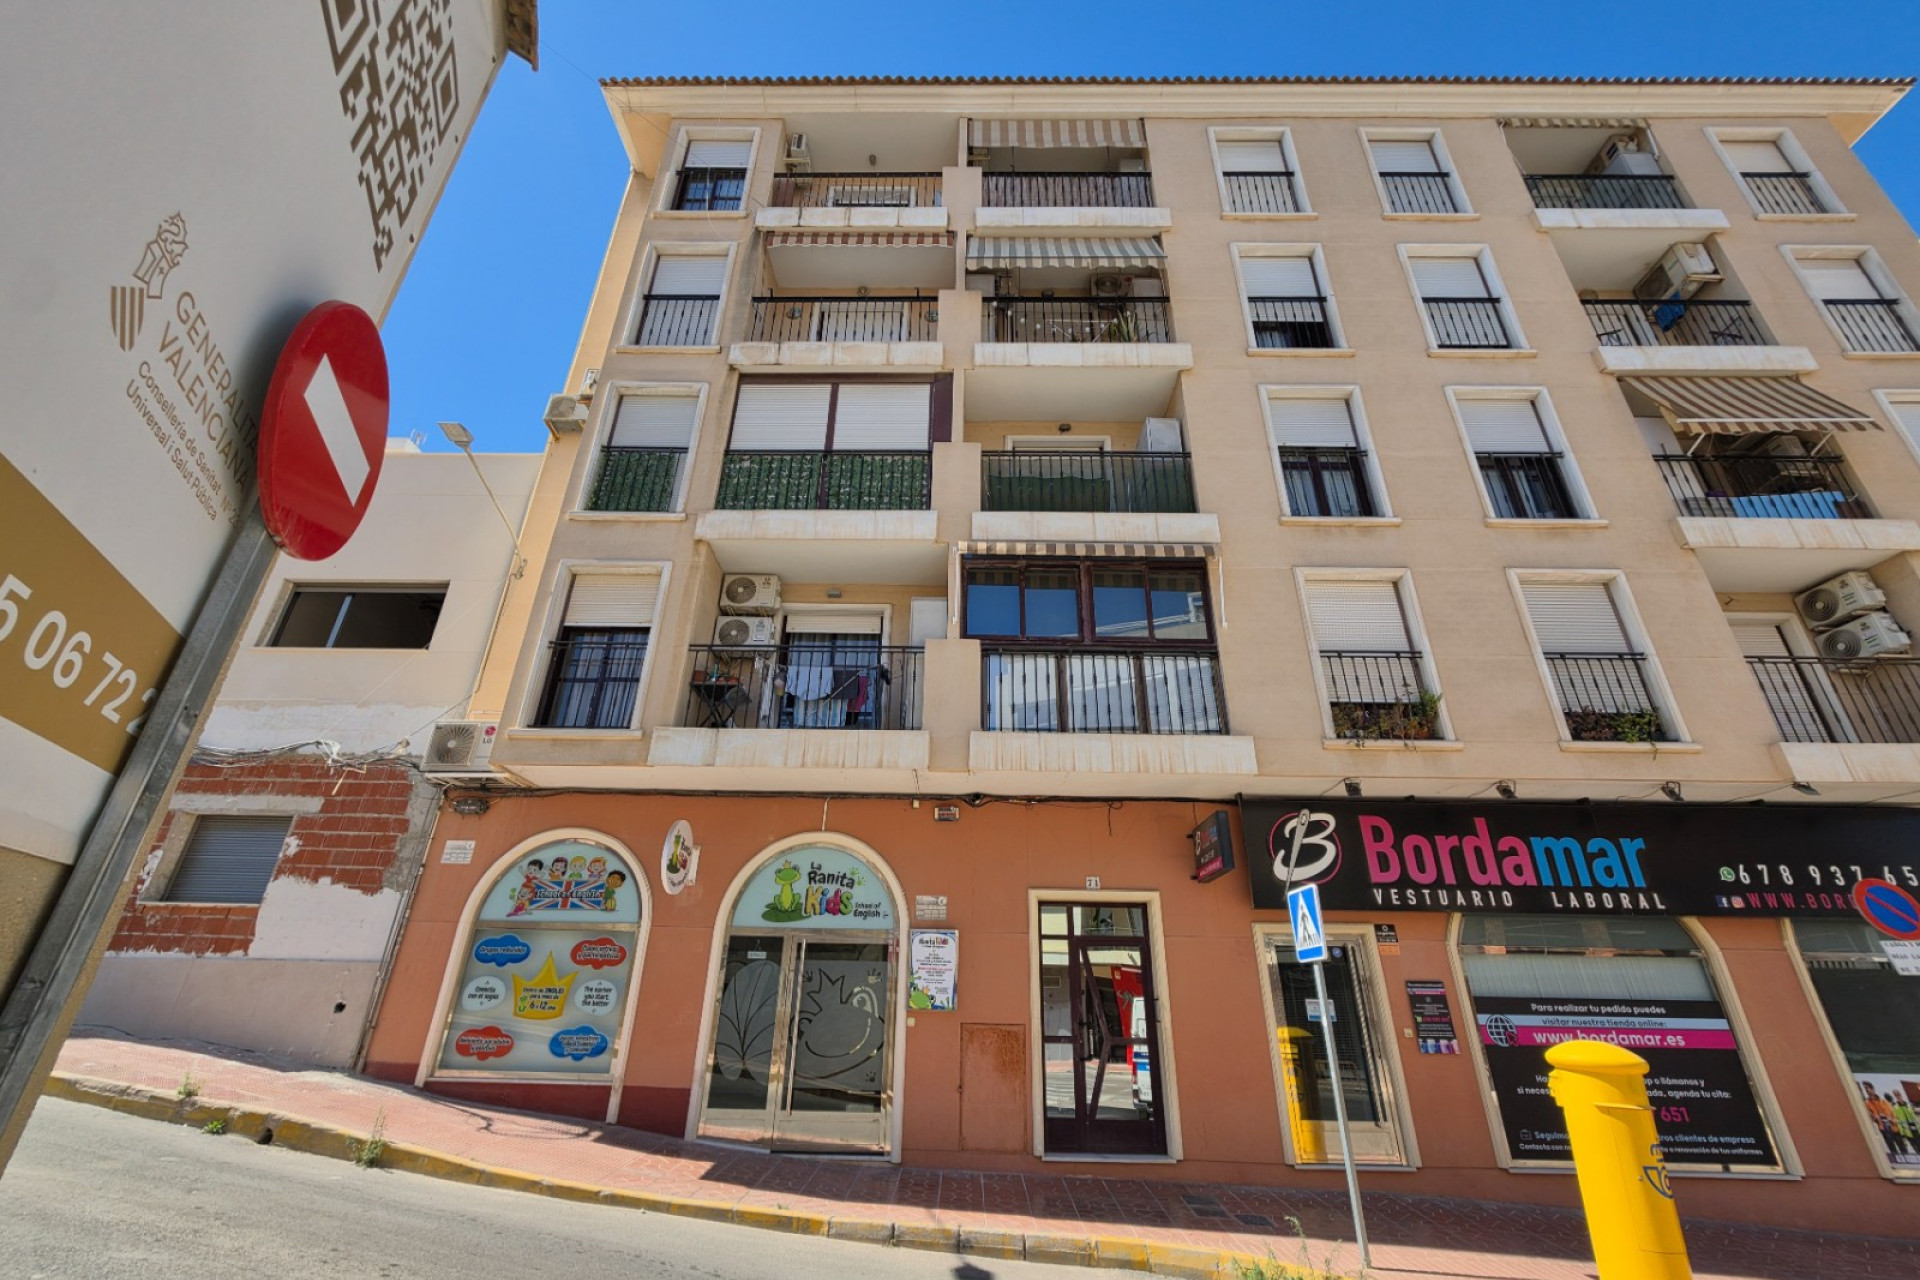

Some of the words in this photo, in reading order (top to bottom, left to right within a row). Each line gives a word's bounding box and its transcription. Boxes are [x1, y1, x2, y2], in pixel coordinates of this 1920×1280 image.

[176, 291, 258, 458] GENERALITA
[158, 320, 249, 494] VALENCIANA
[126, 379, 172, 449] Universal
[172, 447, 195, 485] Salut
[191, 477, 217, 521] Pública
[185, 438, 197, 457] de
[196, 452, 222, 495] Sanitat
[24, 610, 92, 689] 06
[83, 652, 137, 724] 72
[1358, 814, 1647, 888] Bordamar
[811, 861, 822, 871] La
[1739, 864, 1794, 886] 678
[1808, 865, 1862, 887] 937
[808, 870, 855, 890] Ranita
[804, 885, 854, 916] Kids
[1373, 888, 1514, 908] VESTUARIO
[1550, 891, 1667, 910] LABORAL
[853, 909, 881, 921] English
[1530, 1003, 1553, 1013] Para
[1554, 1003, 1588, 1013] realizar
[1589, 1004, 1599, 1013] tu
[1601, 1004, 1632, 1015] pedido
[1633, 1005, 1667, 1015] puedes
[1541, 1018, 1571, 1026] visitar
[1571, 1018, 1606, 1027] nuestra
[1606, 1019, 1636, 1028] tienda
[1533, 1029, 1685, 1047] wwwbordamar.es
[1668, 1090, 1700, 1099] agenda
[1701, 1090, 1711, 1098] tu
[1660, 1106, 1690, 1122] 651
[1674, 1134, 1707, 1143] clientes
[1708, 1135, 1719, 1143] de
[1720, 1136, 1756, 1145] empresa
